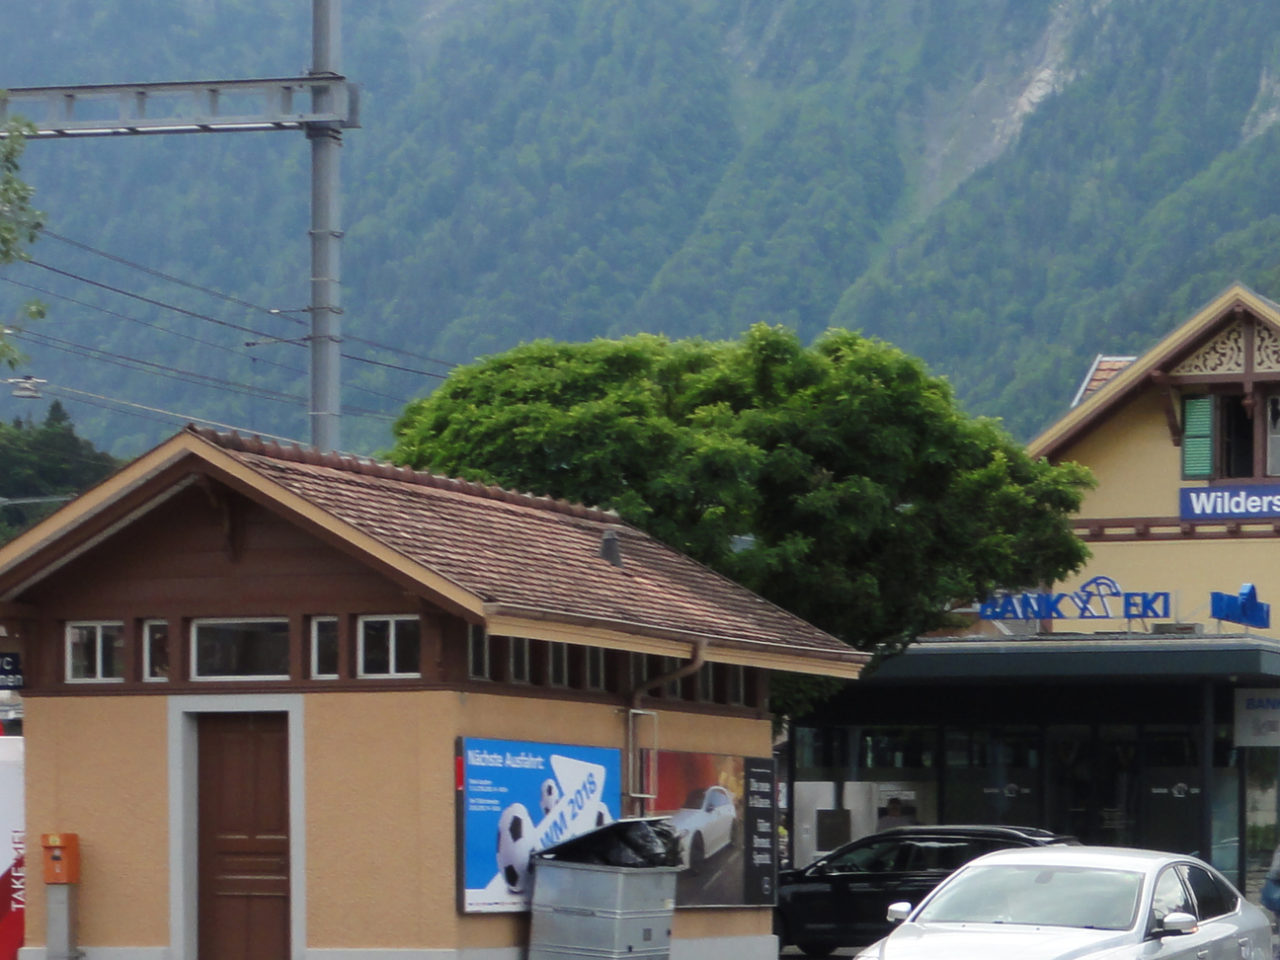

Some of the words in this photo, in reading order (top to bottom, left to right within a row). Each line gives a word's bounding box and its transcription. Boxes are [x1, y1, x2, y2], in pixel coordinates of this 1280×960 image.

[1123, 592, 1170, 618] EKI
[467, 750, 503, 767] Nächste
[540, 811, 568, 848] WM
[567, 772, 597, 821] 2018
